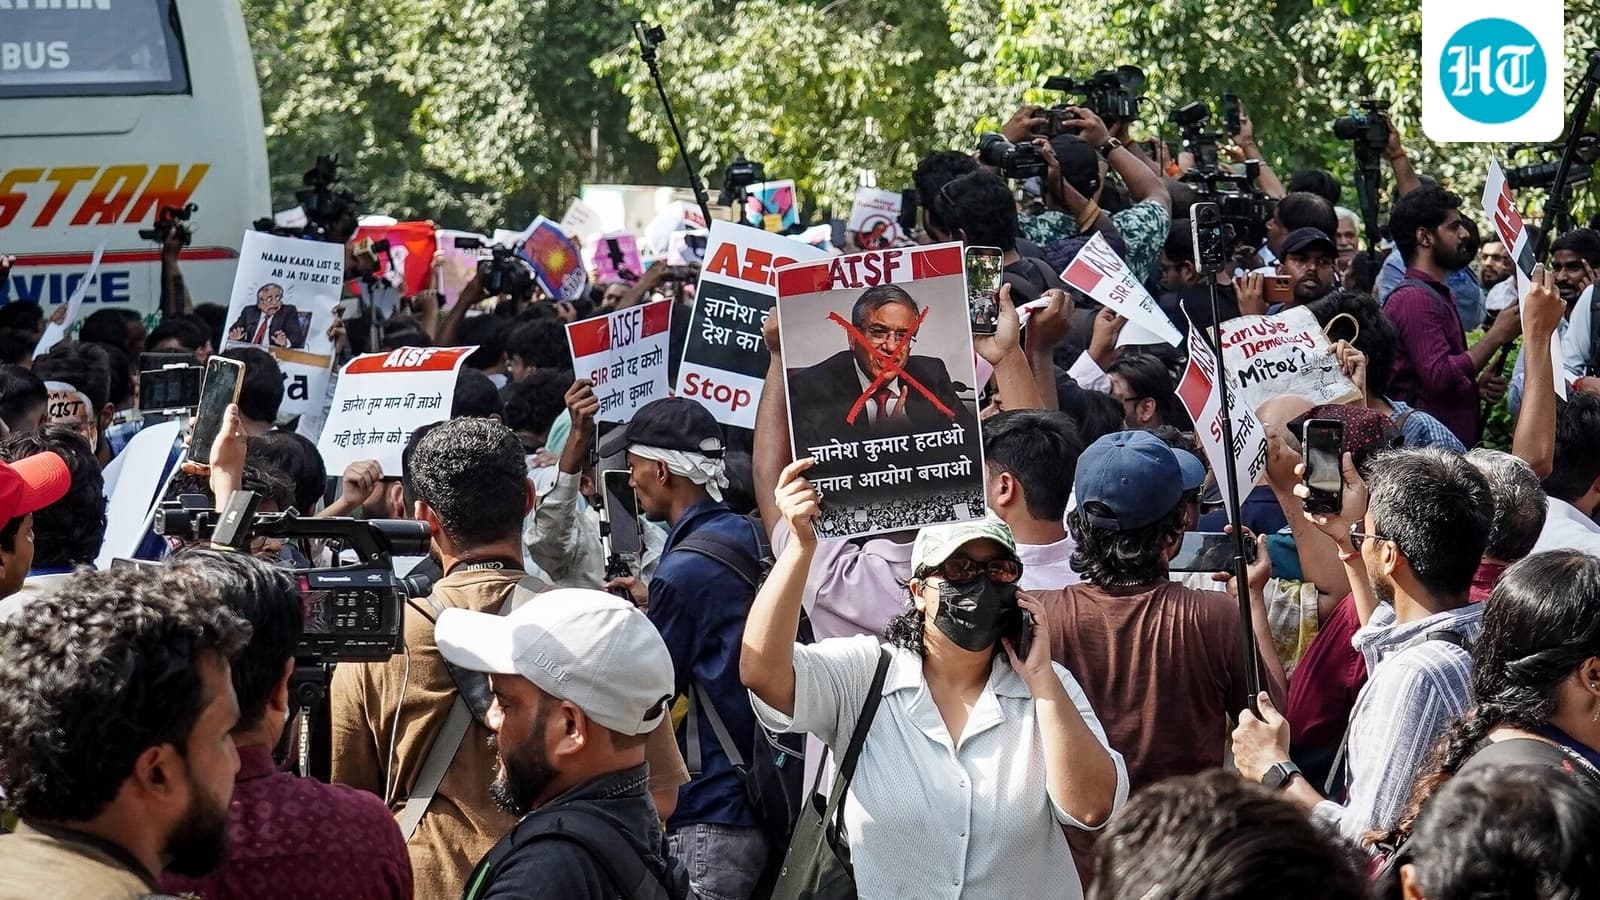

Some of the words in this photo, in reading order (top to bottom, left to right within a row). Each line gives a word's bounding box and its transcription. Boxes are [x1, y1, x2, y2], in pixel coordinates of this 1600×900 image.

[2, 41, 70, 70] BUS
[261, 252, 287, 264] NAAM
[289, 257, 314, 268] KAATA
[317, 260, 331, 270] LIST
[829, 251, 902, 289] AISF
[1082, 234, 1122, 279] AIS
[0, 271, 130, 306] VICE
[271, 268, 283, 278] AB
[286, 271, 296, 280] JA
[299, 271, 309, 280] TU
[311, 273, 330, 283] SEAT
[704, 296, 757, 325] ज्ञानेश
[1109, 285, 1131, 304] SIR
[611, 309, 641, 350] AISF
[702, 317, 732, 346] देश
[736, 329, 762, 353] का
[382, 348, 435, 368] AISF
[590, 366, 609, 387] SIR
[611, 356, 624, 380] को
[627, 356, 639, 377] रद्द
[641, 344, 663, 369] करो!
[341, 394, 367, 414] ज्ञानेश
[367, 398, 383, 415] तुम
[384, 397, 402, 409] मान
[403, 392, 416, 409] भी
[416, 392, 442, 409] जाओ
[600, 388, 625, 415] ज्ञानेश
[629, 380, 655, 408] कुमार
[683, 372, 751, 412] Stop
[367, 427, 385, 444] जेल
[386, 427, 402, 444] को
[807, 438, 859, 465] ज्ञानेश
[862, 435, 910, 462] कुमार
[913, 423, 965, 452] हटाओ
[858, 464, 913, 487] आयोग
[916, 455, 973, 480] बचाओ
